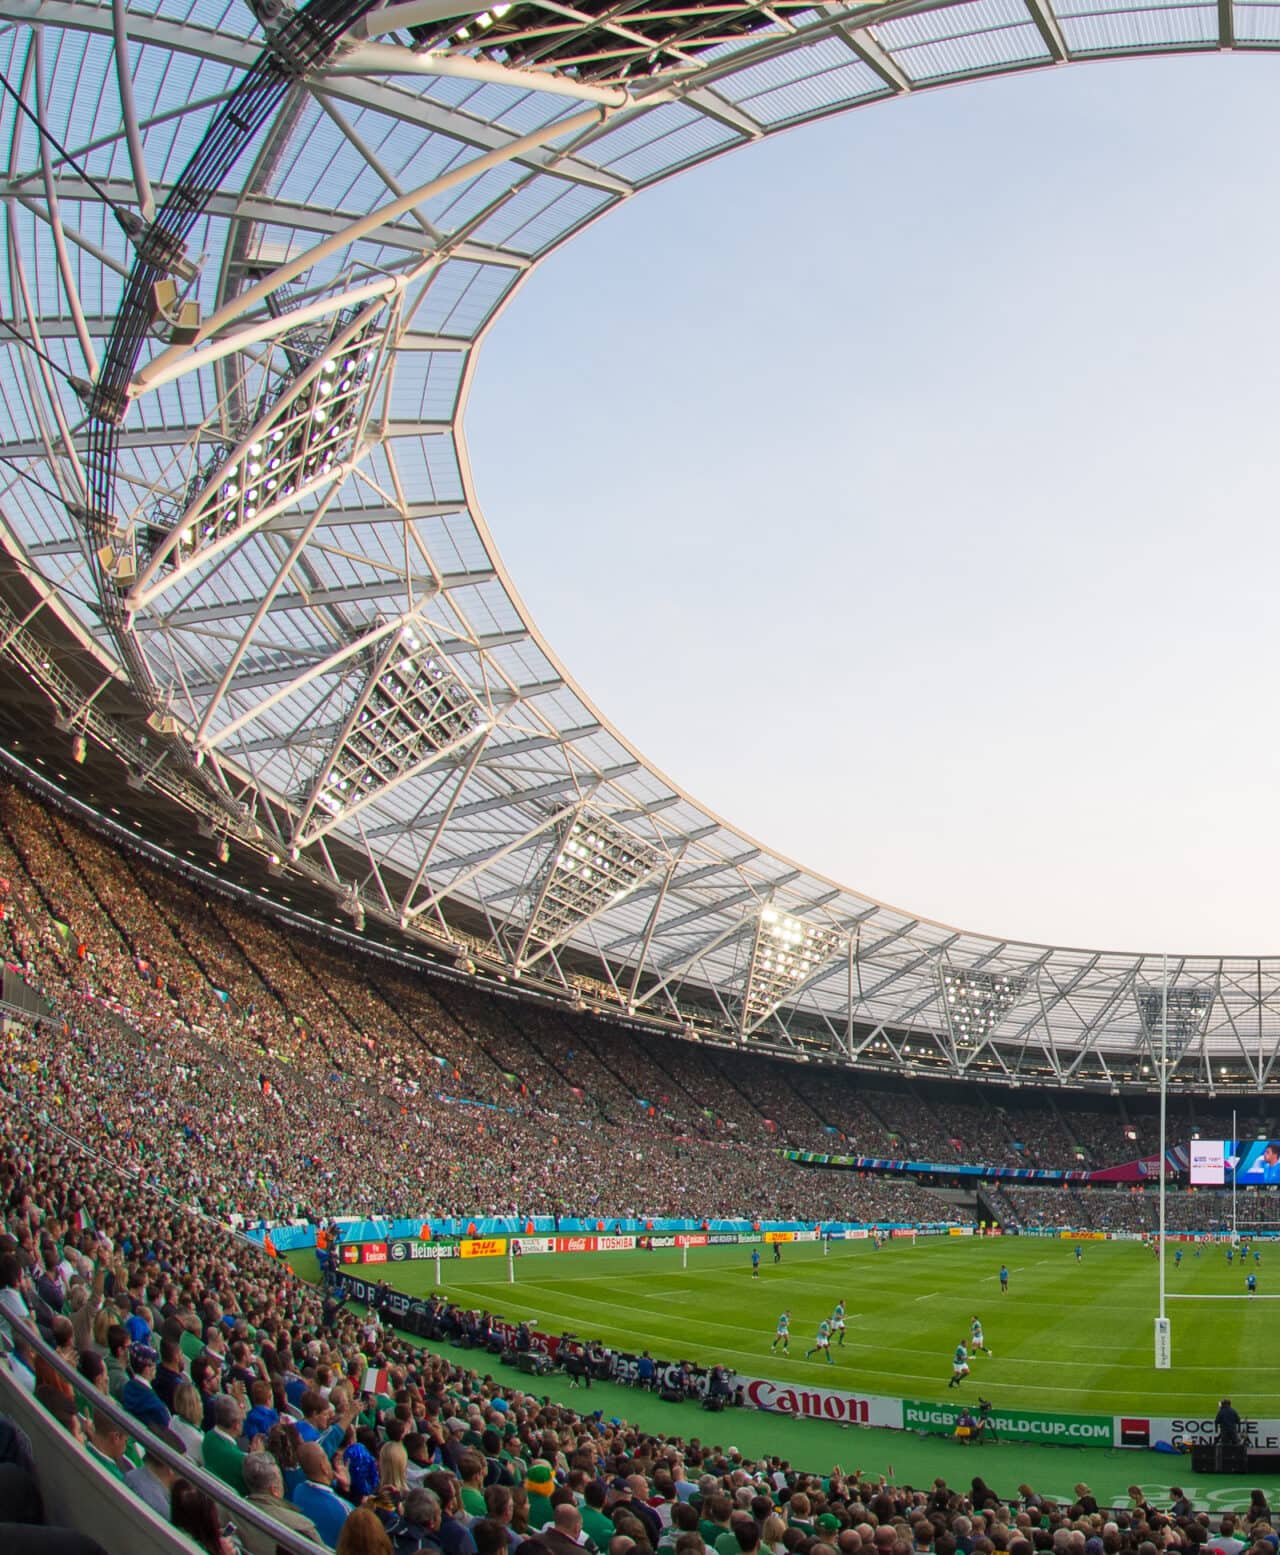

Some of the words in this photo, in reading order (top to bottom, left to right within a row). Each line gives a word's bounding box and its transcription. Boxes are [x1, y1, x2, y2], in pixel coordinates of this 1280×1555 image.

[472, 1241, 498, 1255] DHL
[601, 1237, 633, 1249] TOSHIBA
[748, 1380, 869, 1422] Canon
